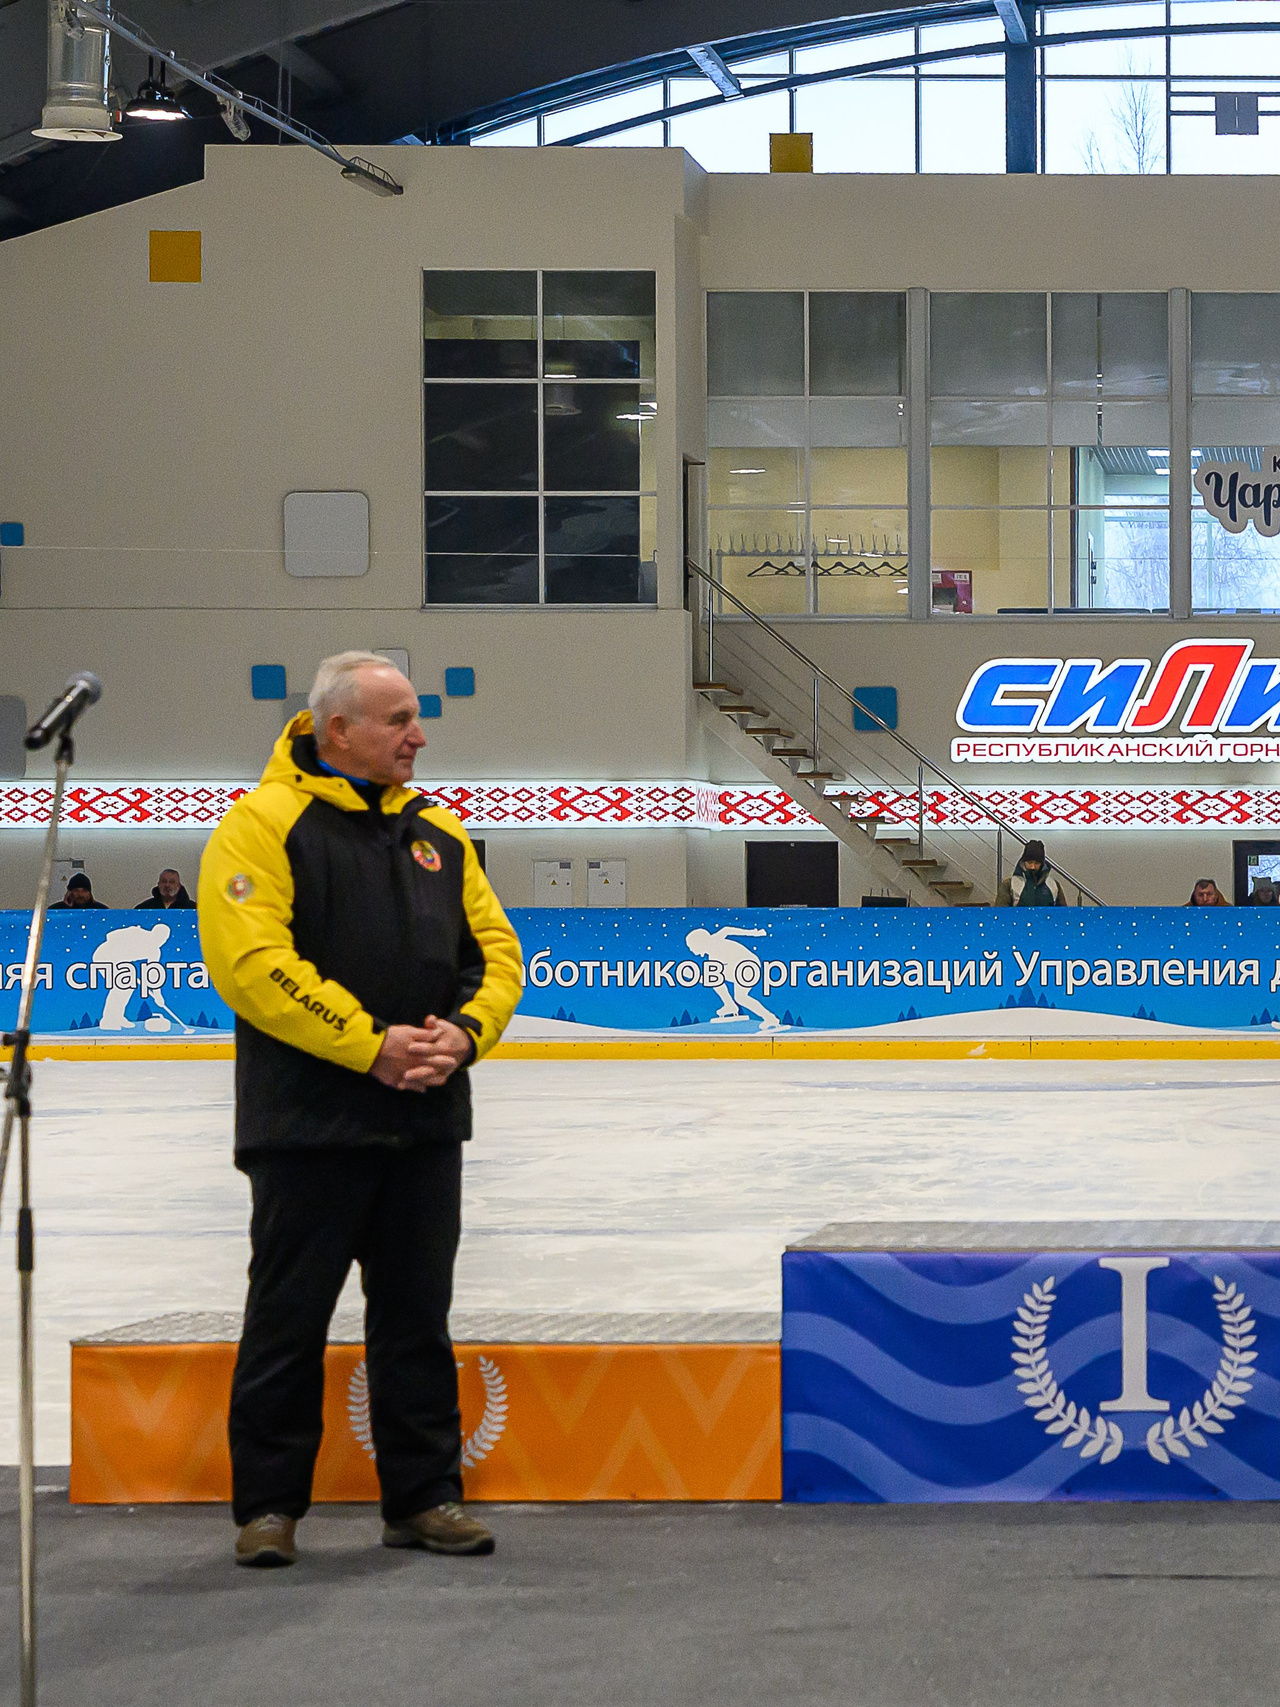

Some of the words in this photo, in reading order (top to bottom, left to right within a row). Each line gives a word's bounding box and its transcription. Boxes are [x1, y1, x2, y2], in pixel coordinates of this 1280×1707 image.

[956, 739, 1213, 757] РЕСПУБЛИКАНСКИЙ
[270, 967, 347, 1031] BELARUS
[734, 950, 1003, 996] организаций
[1012, 950, 1261, 995] Управления
[1099, 1256, 1170, 1412] I
